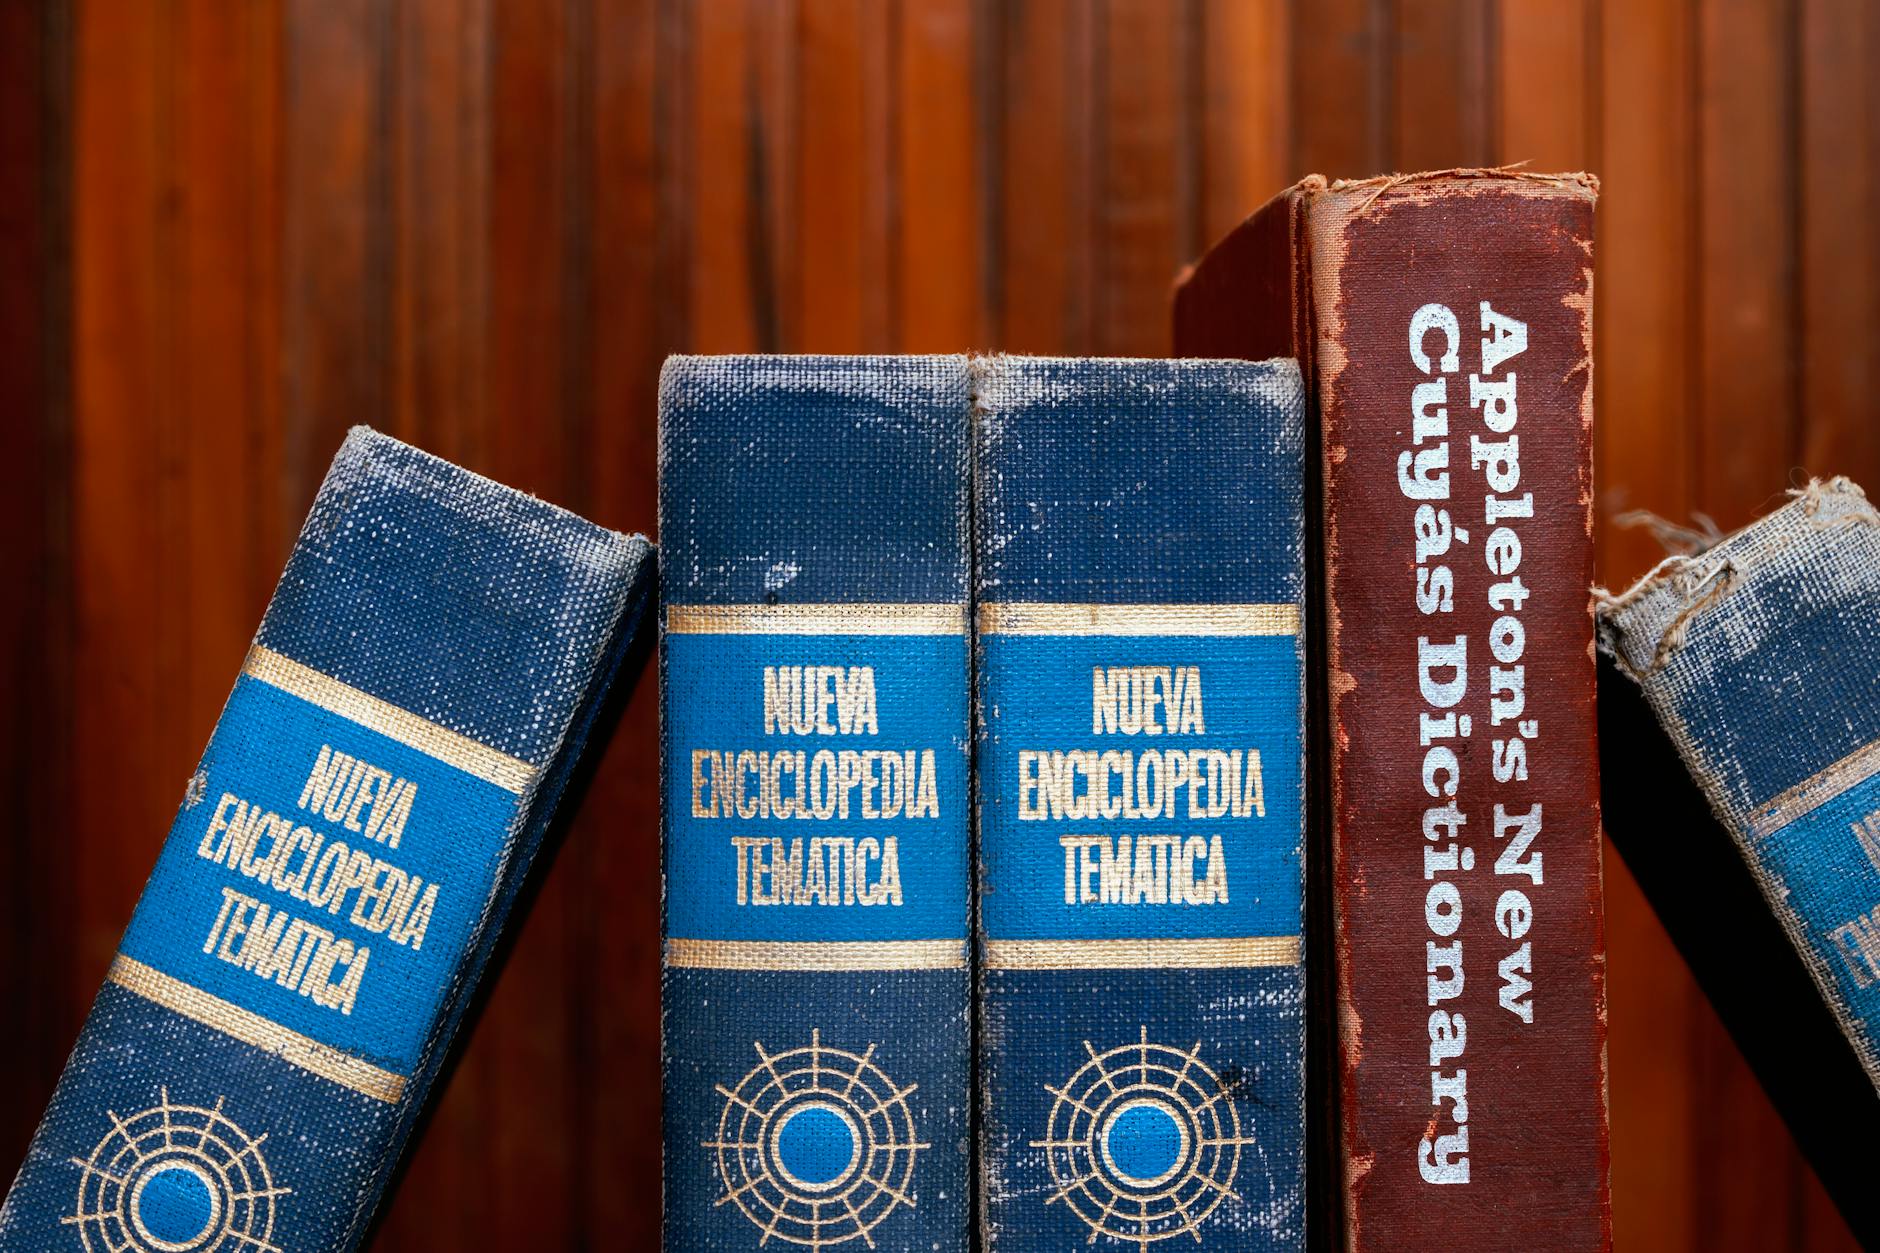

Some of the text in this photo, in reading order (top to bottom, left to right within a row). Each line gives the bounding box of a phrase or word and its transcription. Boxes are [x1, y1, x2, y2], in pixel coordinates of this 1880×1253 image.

[1469, 300, 1544, 1025] Appleton's New
[763, 665, 879, 736] NUEVA
[1092, 664, 1205, 736] NUEVA
[1397, 302, 1475, 1185] Cuyás Dictionary
[297, 743, 418, 850] NUEVA
[691, 748, 940, 820] ENCICLOPEDIA
[1017, 748, 1266, 821] ENCICLOPEDIA
[197, 791, 441, 951] ENCICLOPEDIA
[730, 835, 904, 907] TEMATICA
[1058, 833, 1230, 905] TEMATICA
[203, 885, 371, 1016] TEMATICA
